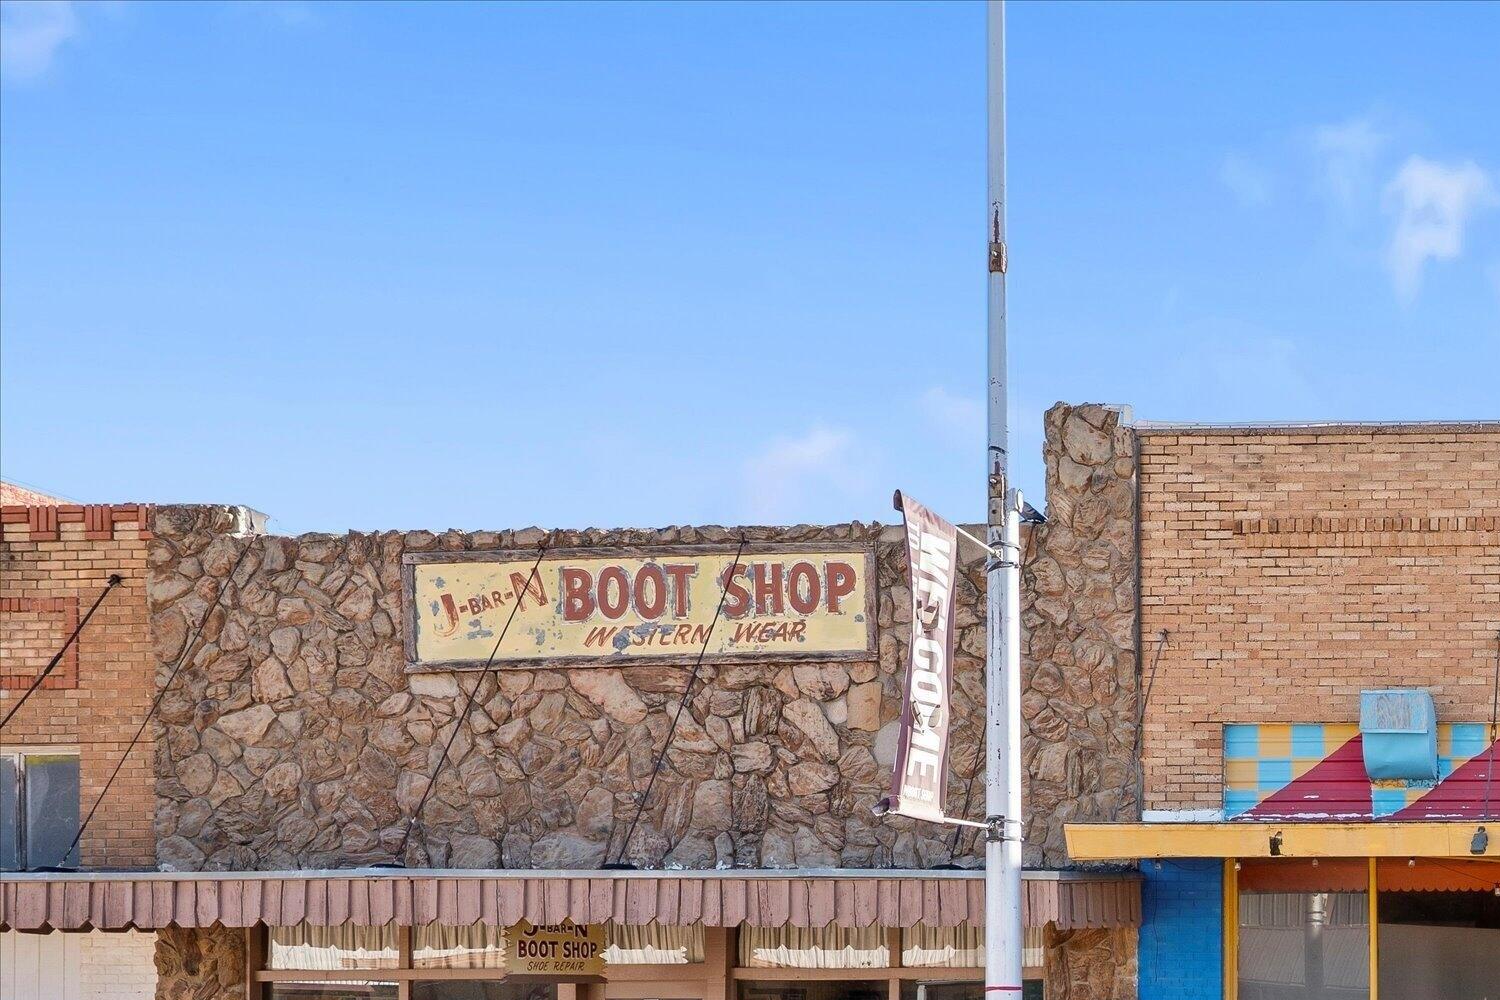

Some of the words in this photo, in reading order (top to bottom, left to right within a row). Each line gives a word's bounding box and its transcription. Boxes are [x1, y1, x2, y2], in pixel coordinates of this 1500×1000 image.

[562, 564, 696, 621] BOOT
[721, 562, 857, 617] SHOP
[583, 624, 714, 648] WSTERN
[733, 621, 807, 644] WEAR
[518, 939, 559, 958] BOOT
[562, 941, 598, 959] SHOP
[527, 961, 549, 971] SHOE
[554, 961, 586, 971] REPAIR
